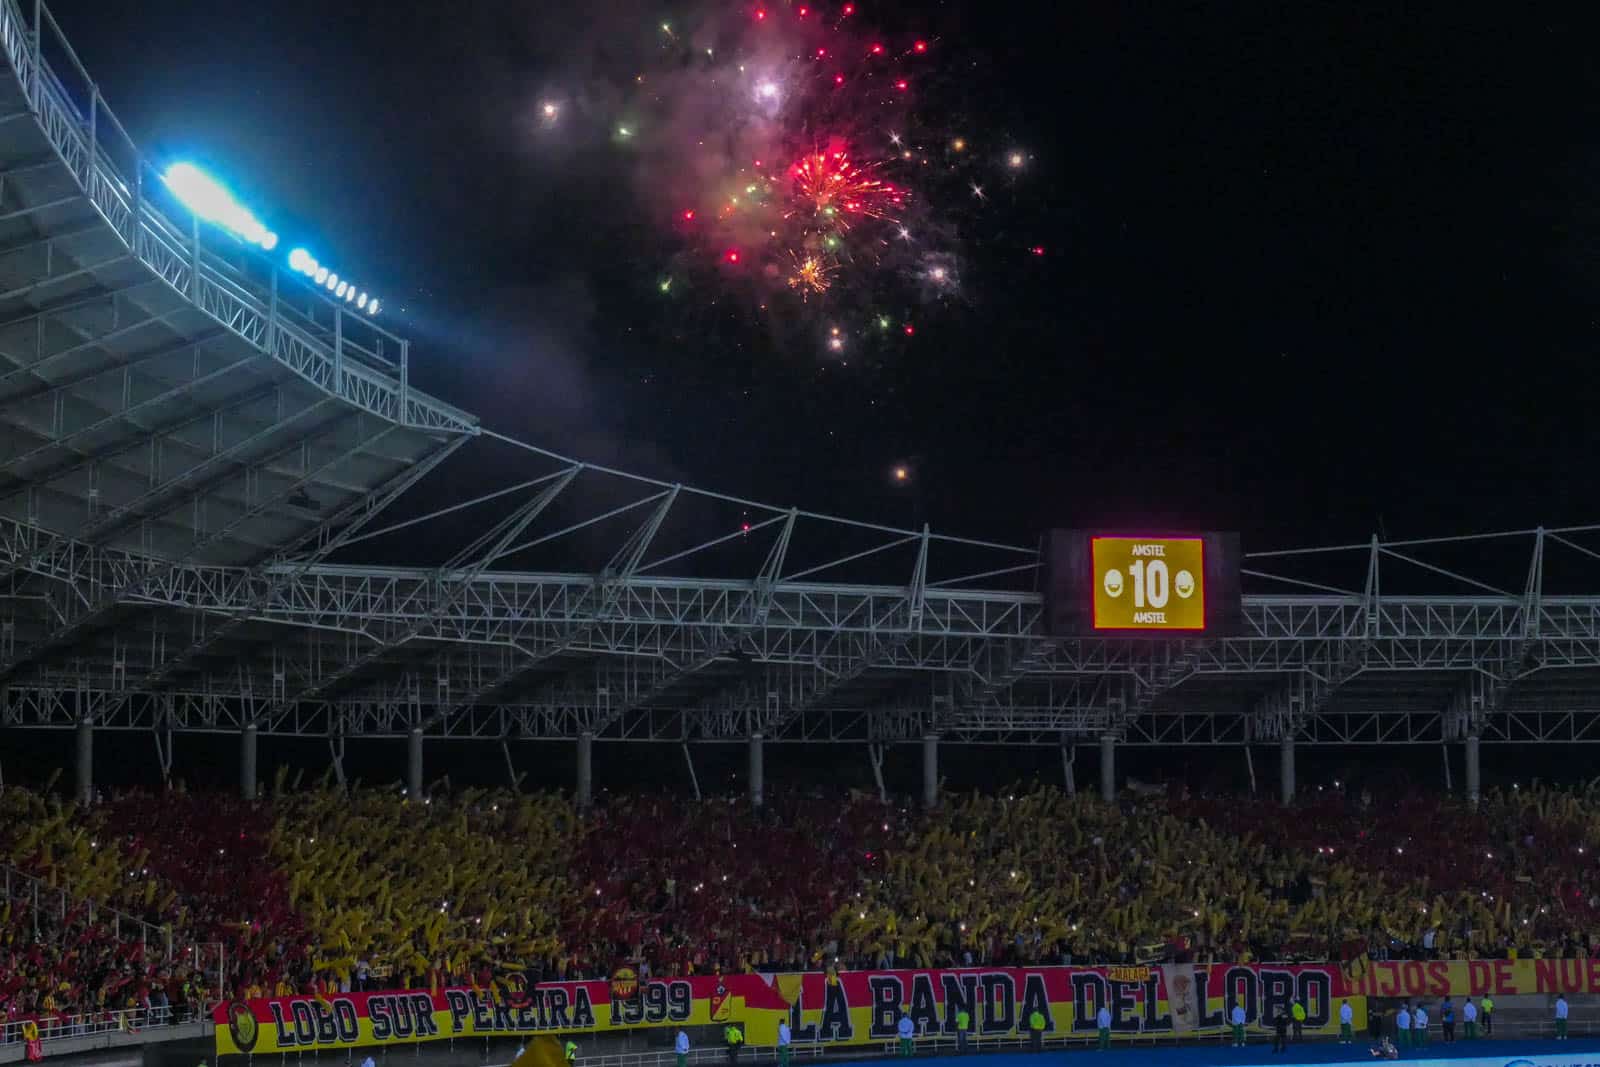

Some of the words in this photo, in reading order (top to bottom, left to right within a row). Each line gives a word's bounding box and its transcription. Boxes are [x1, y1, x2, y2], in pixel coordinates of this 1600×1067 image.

[1128, 559, 1169, 609] 10
[789, 973, 854, 1043] LA
[868, 971, 1055, 1038] BANDA
[1070, 970, 1174, 1034] DEL
[1193, 966, 1331, 1030] LOBO
[1468, 959, 1520, 997] DE
[269, 997, 361, 1049] LOBO
[367, 991, 439, 1040] SUR
